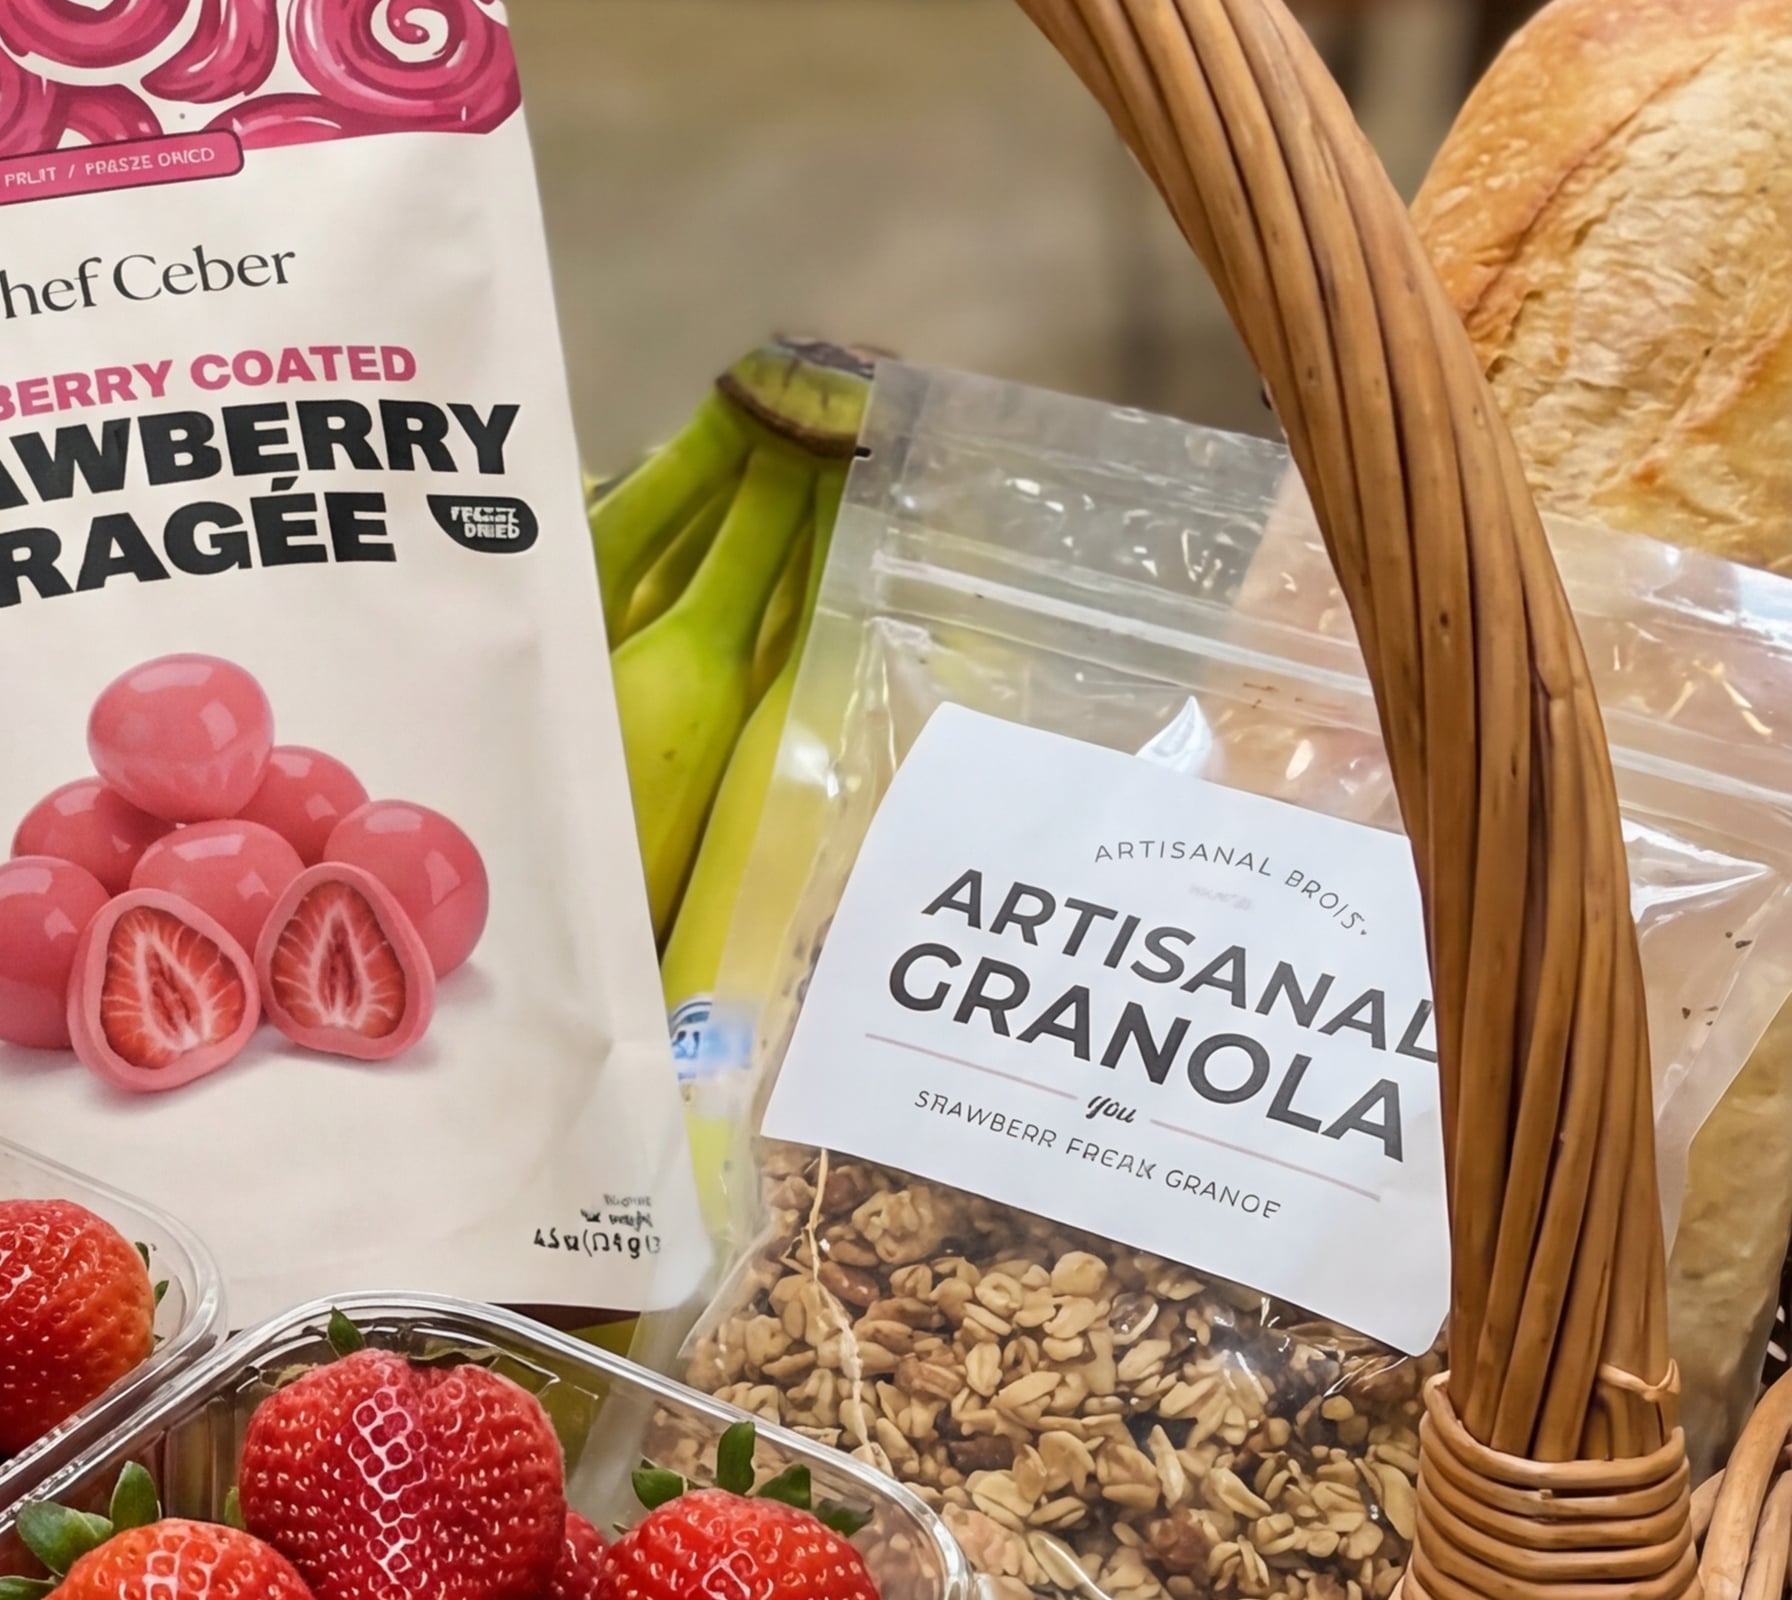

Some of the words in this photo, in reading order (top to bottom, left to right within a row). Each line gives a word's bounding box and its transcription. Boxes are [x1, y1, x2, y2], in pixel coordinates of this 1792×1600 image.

[112, 244, 296, 301] Ceber
[190, 346, 417, 390] COATED
[1095, 840, 1272, 877] ARTISANAL
[921, 868, 1438, 1063] ARTISANAL
[889, 941, 1404, 1163] GRANOLA
